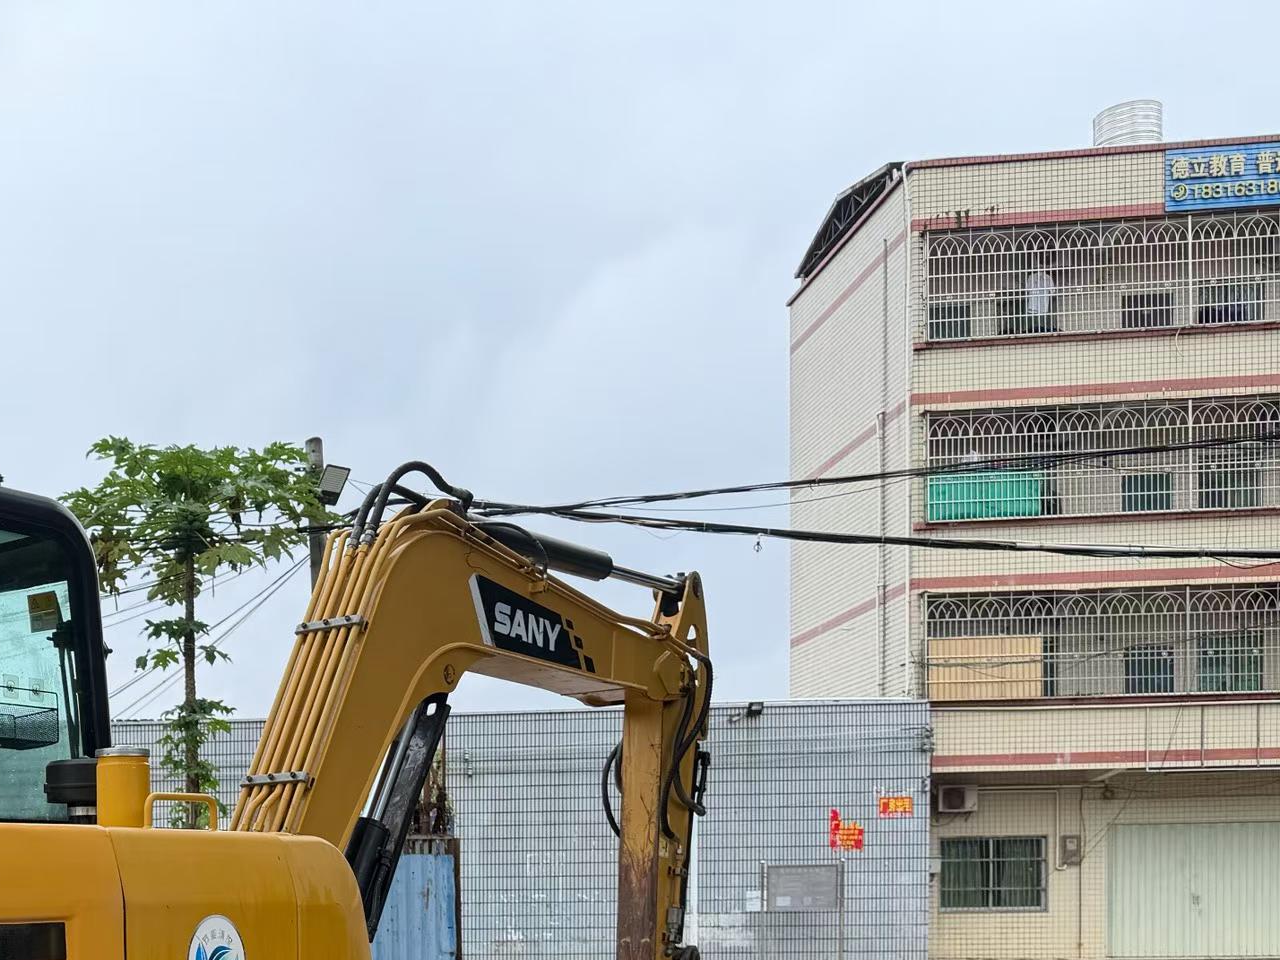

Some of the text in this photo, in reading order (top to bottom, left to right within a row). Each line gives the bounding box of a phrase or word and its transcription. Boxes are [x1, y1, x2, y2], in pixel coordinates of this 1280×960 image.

[1256, 151, 1280, 174] 普
[1193, 180, 1280, 199] 18316318
[494, 601, 561, 652] SANY
